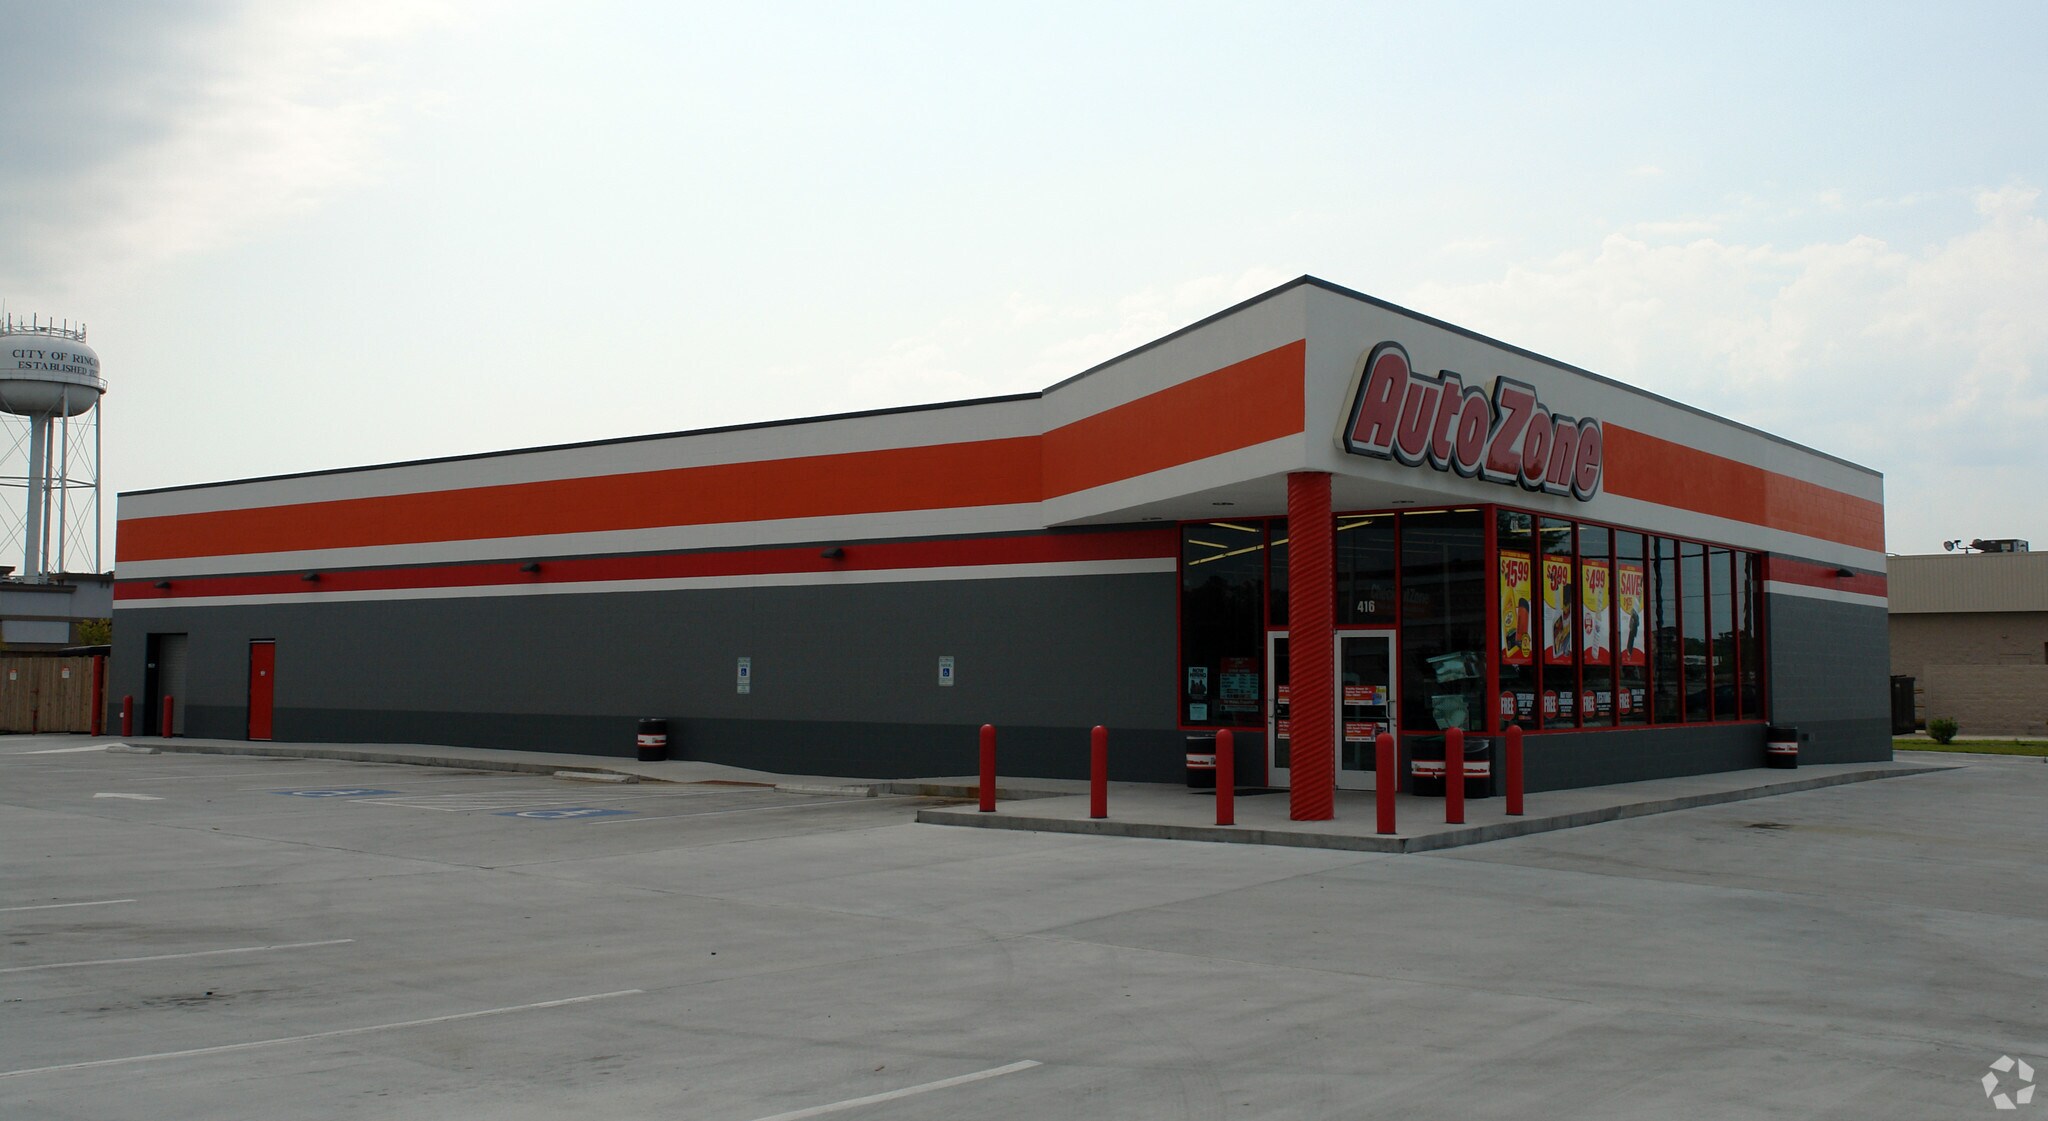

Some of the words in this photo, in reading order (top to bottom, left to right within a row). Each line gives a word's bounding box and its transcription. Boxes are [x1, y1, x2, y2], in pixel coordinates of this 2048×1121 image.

[13, 349, 45, 359] CITY
[51, 352, 67, 361] OF
[19, 361, 87, 375] ESTABLISHED
[1348, 347, 1602, 496] AutoZone
[1357, 600, 1375, 613] 416
[1501, 697, 1514, 714] FREE
[1544, 696, 1556, 713] FREE
[1583, 696, 1595, 712] FREE
[1619, 693, 1630, 709] FREE
